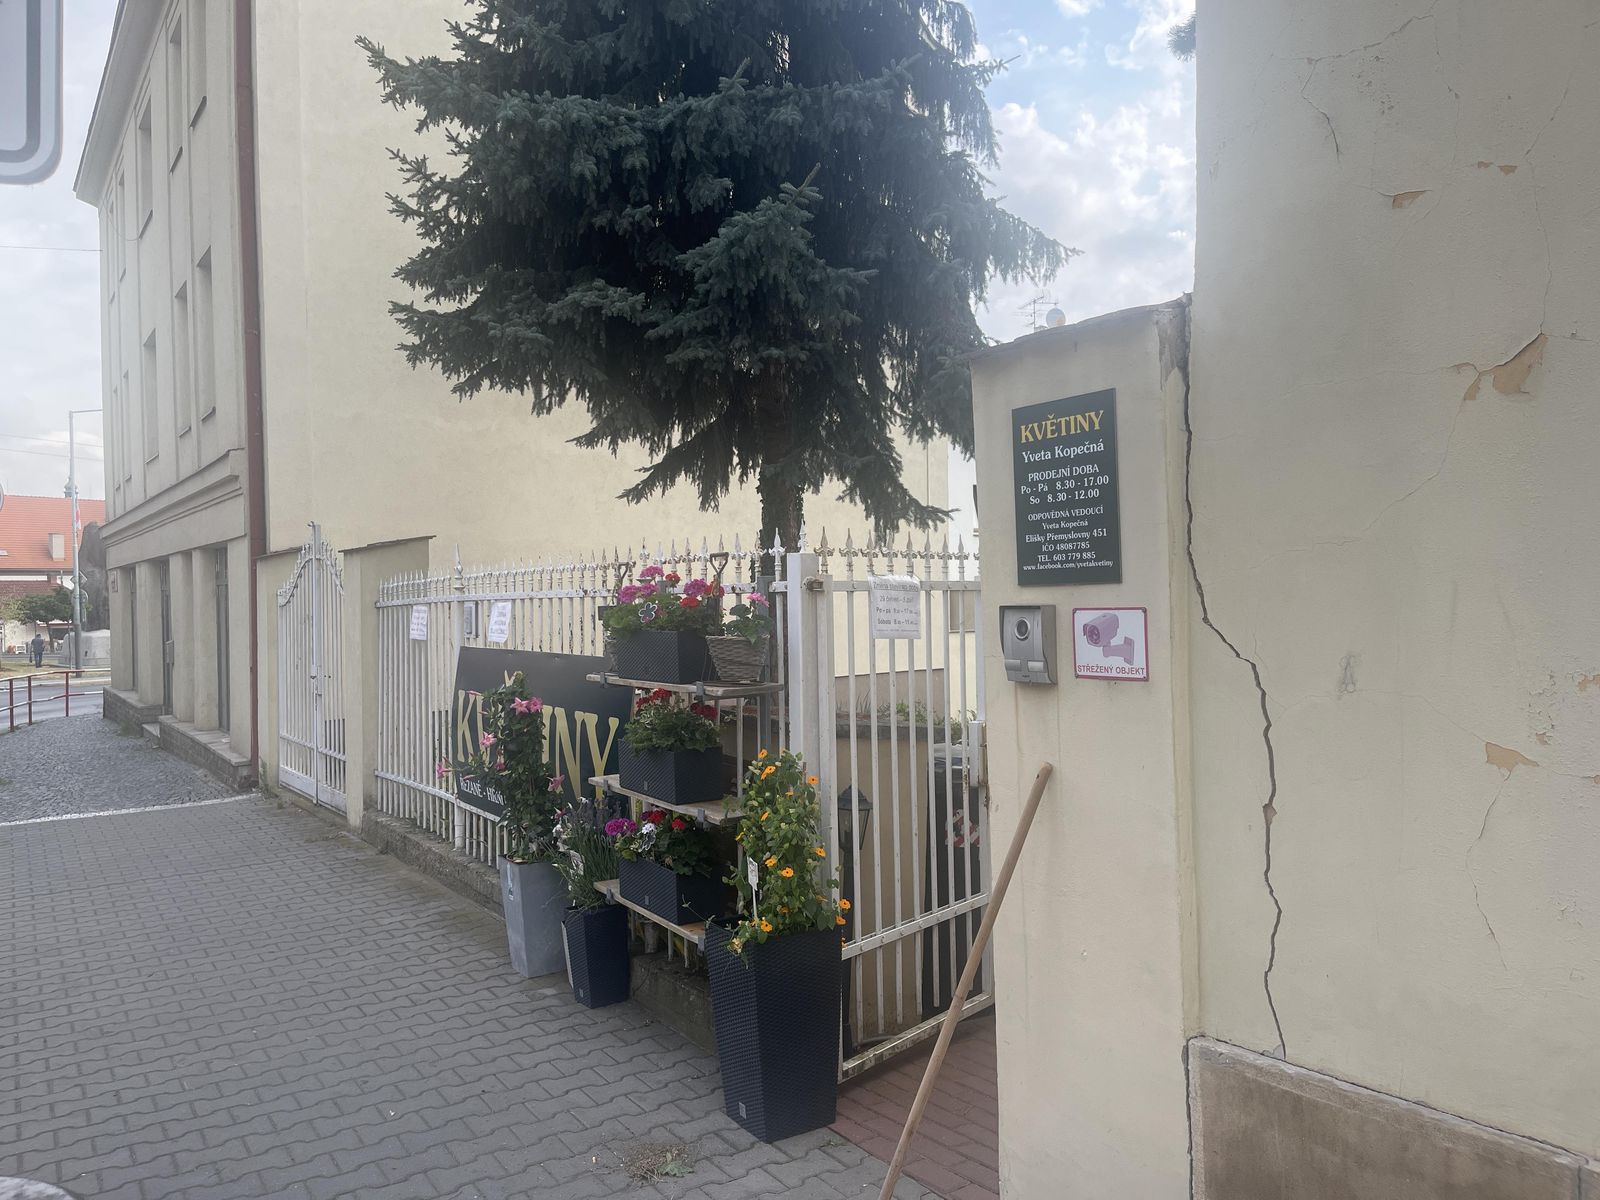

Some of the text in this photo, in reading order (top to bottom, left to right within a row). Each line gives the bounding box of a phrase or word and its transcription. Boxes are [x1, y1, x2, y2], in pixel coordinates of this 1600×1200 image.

[1020, 410, 1104, 443] KVĚTINY
[1022, 439, 1104, 463] Yveta Kopečná
[1028, 464, 1099, 482] PRODEJNÍ DOBA
[1021, 486, 1031, 494] Po
[1038, 483, 1048, 492] Pá
[1056, 479, 1075, 490] 8.30
[1084, 475, 1109, 487] 17.00
[1030, 496, 1040, 504] So
[1047, 493, 1066, 502] 8.30
[1075, 489, 1100, 500] 12.00
[1028, 505, 1104, 521] ODPOVĚDNÁ VEDOUCÍ
[1042, 519, 1088, 530] Yveta Kopečná
[1026, 528, 1107, 543] Elišky Přemyslovny 451
[1042, 542, 1090, 552] IČO 48087785
[1053, 553, 1065, 561] 603
[1068, 552, 1081, 560] 779
[1082, 552, 1096, 560] 885
[1023, 560, 1114, 570] www.facebook.com/yvetakvetiny
[1077, 663, 1145, 675] STŘEŽENÝ OBJEKT
